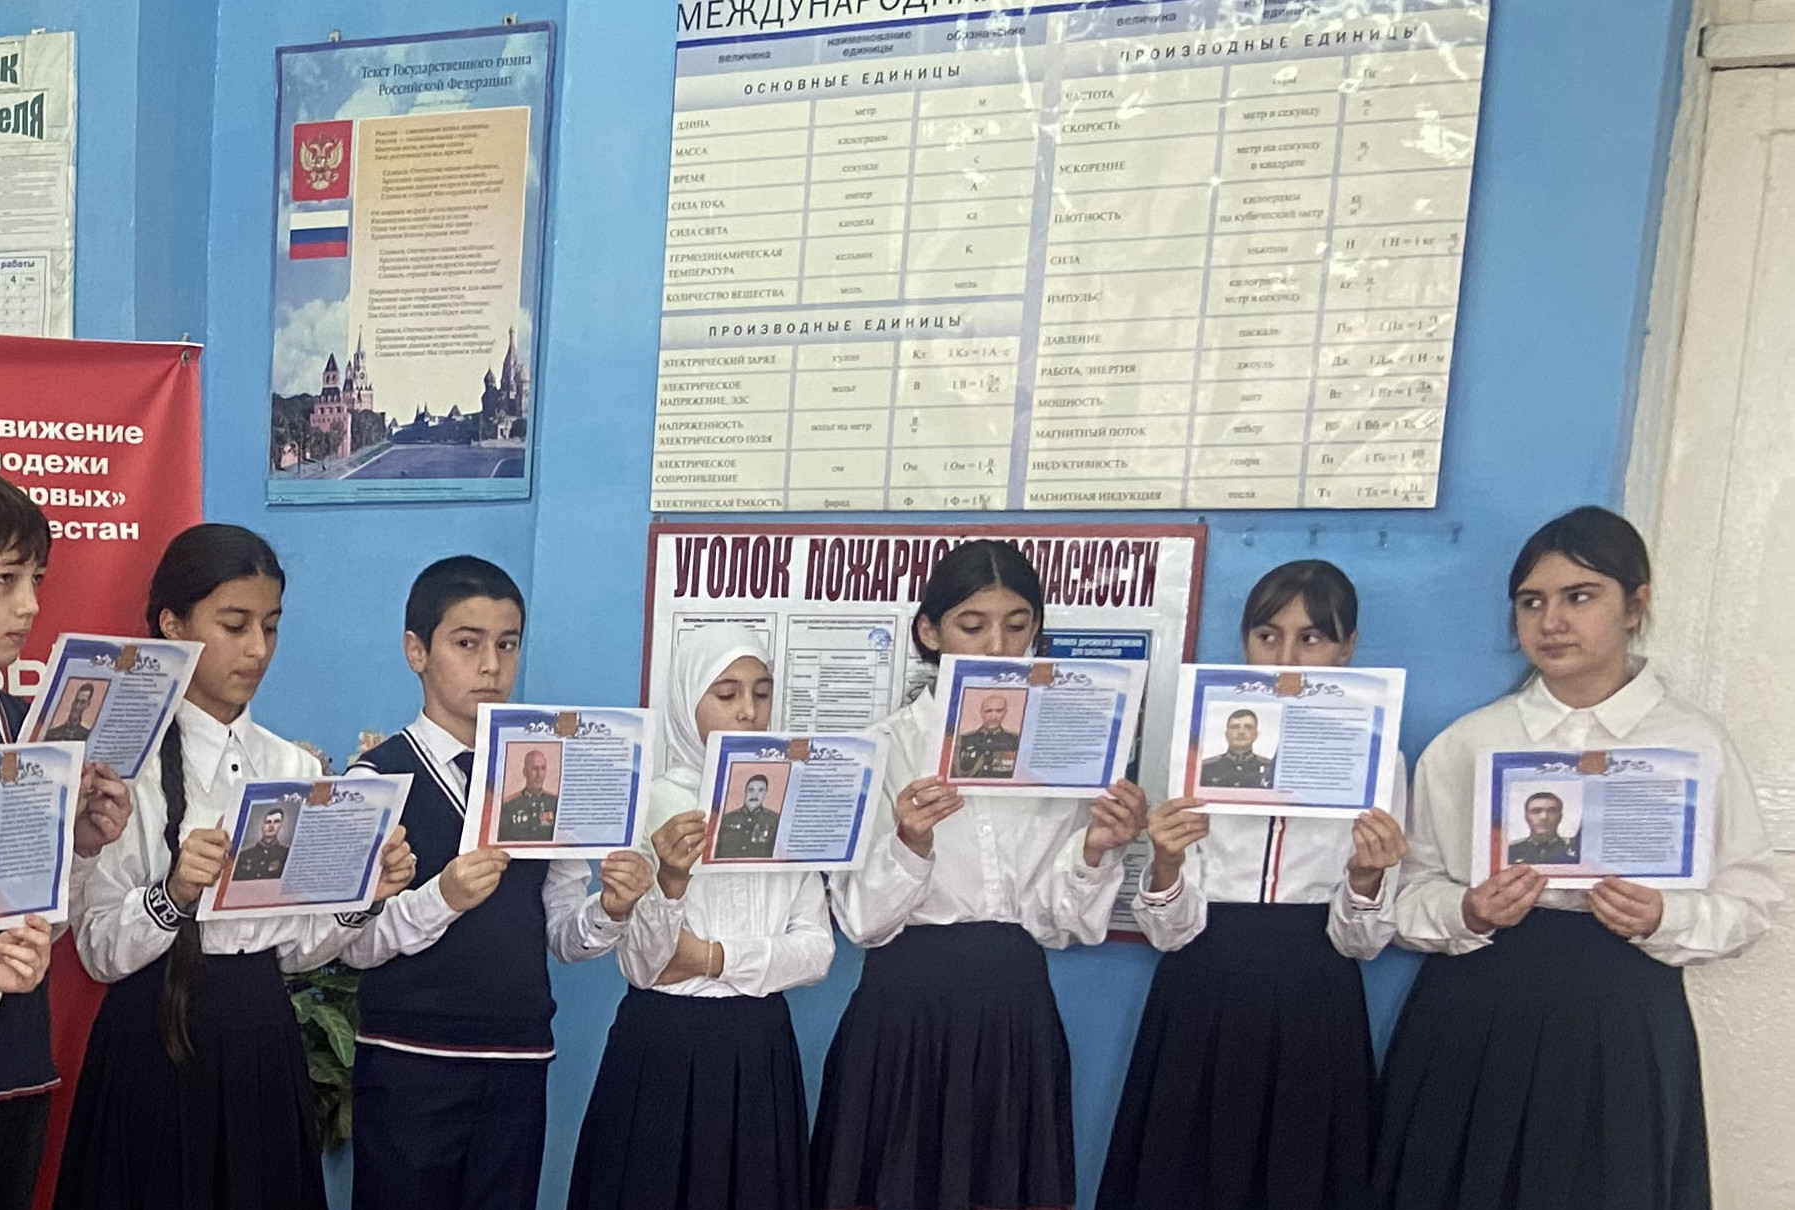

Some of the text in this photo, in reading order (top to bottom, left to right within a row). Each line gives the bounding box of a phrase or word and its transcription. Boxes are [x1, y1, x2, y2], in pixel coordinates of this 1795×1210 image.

[362, 54, 532, 79] Текст Государственного гимна
[378, 75, 513, 96] Российской Федерации
[744, 65, 961, 96] ОСНОВНЫЕ ЕДИНИЦЫ
[1059, 160, 1126, 175] УСКОРЕНИЕ
[0, 259, 36, 270] работы
[708, 315, 961, 338] ПРОИЗВОДНЫЕ ЕДИНИЦЫ
[48, 520, 139, 540] естан
[674, 536, 793, 600] УГОЛОК
[806, 536, 966, 602] ПОЖАРН
